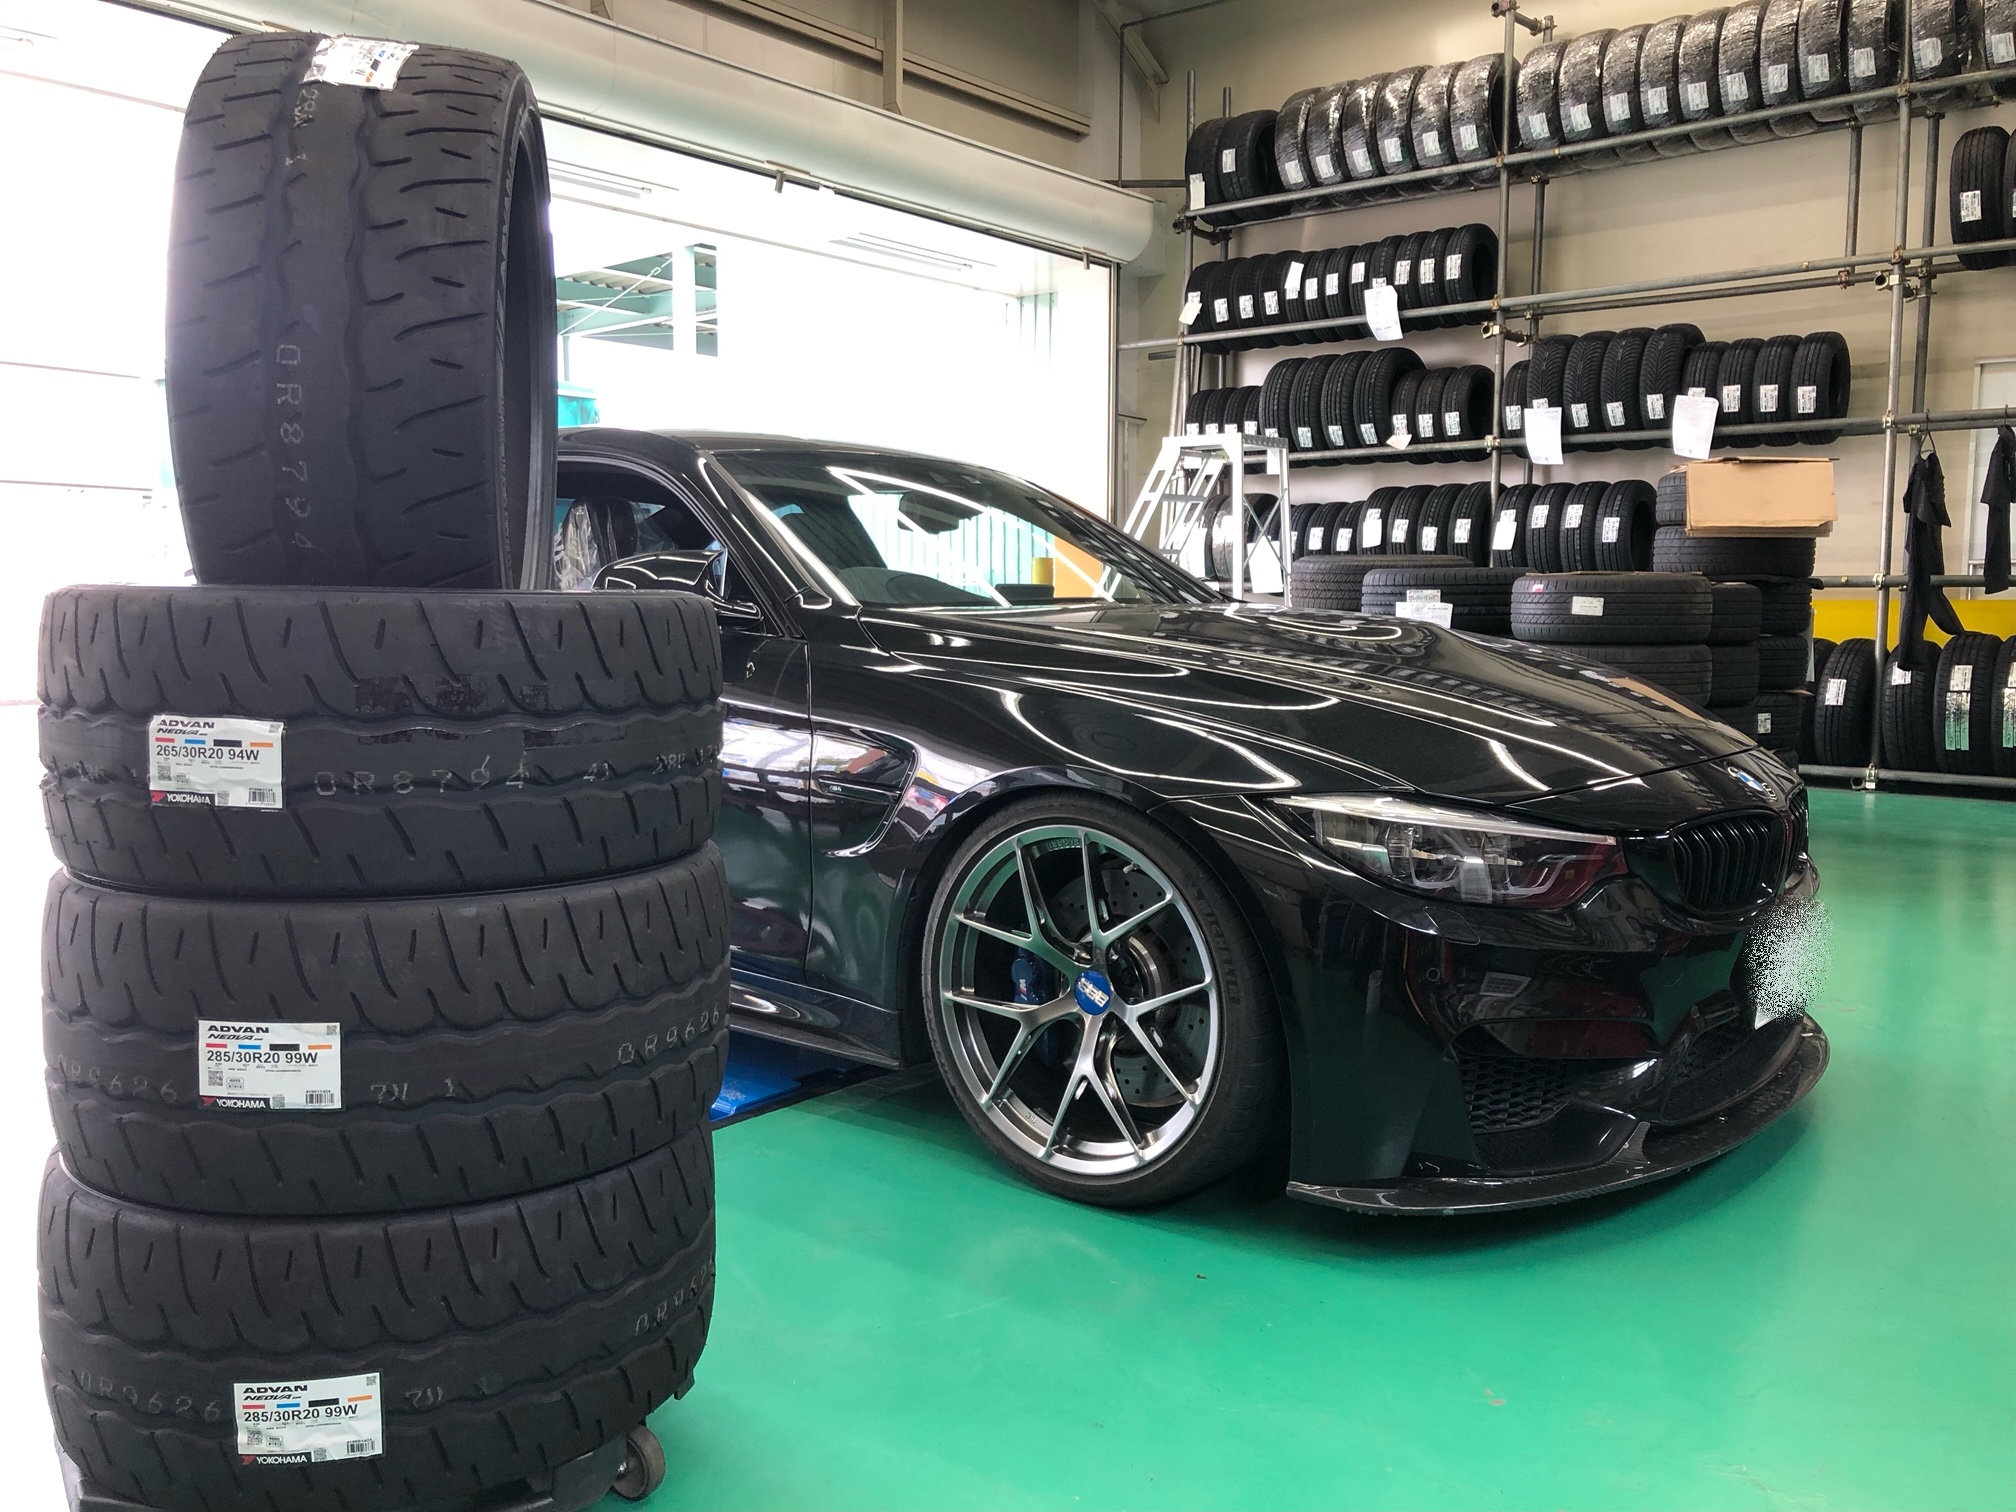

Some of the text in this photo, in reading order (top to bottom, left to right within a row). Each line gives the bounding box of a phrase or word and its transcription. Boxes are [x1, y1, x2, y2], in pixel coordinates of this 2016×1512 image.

[157, 719, 215, 729] ADVAN
[157, 728, 201, 736] NEOVA
[156, 745, 260, 761] 265/30R20 94W
[167, 793, 212, 805] YOKOHAMA
[1076, 977, 1109, 1008] BBS
[207, 1025, 270, 1034] ADVAN
[207, 1033, 255, 1041] NEOVA
[206, 1050, 318, 1064] 285/30R20 99W
[216, 1098, 267, 1109] YOKOHAMA
[243, 1384, 308, 1394] ADVAN
[243, 1403, 359, 1423] 285/30R20 99W
[256, 1455, 308, 1465] YOKOHAMA
